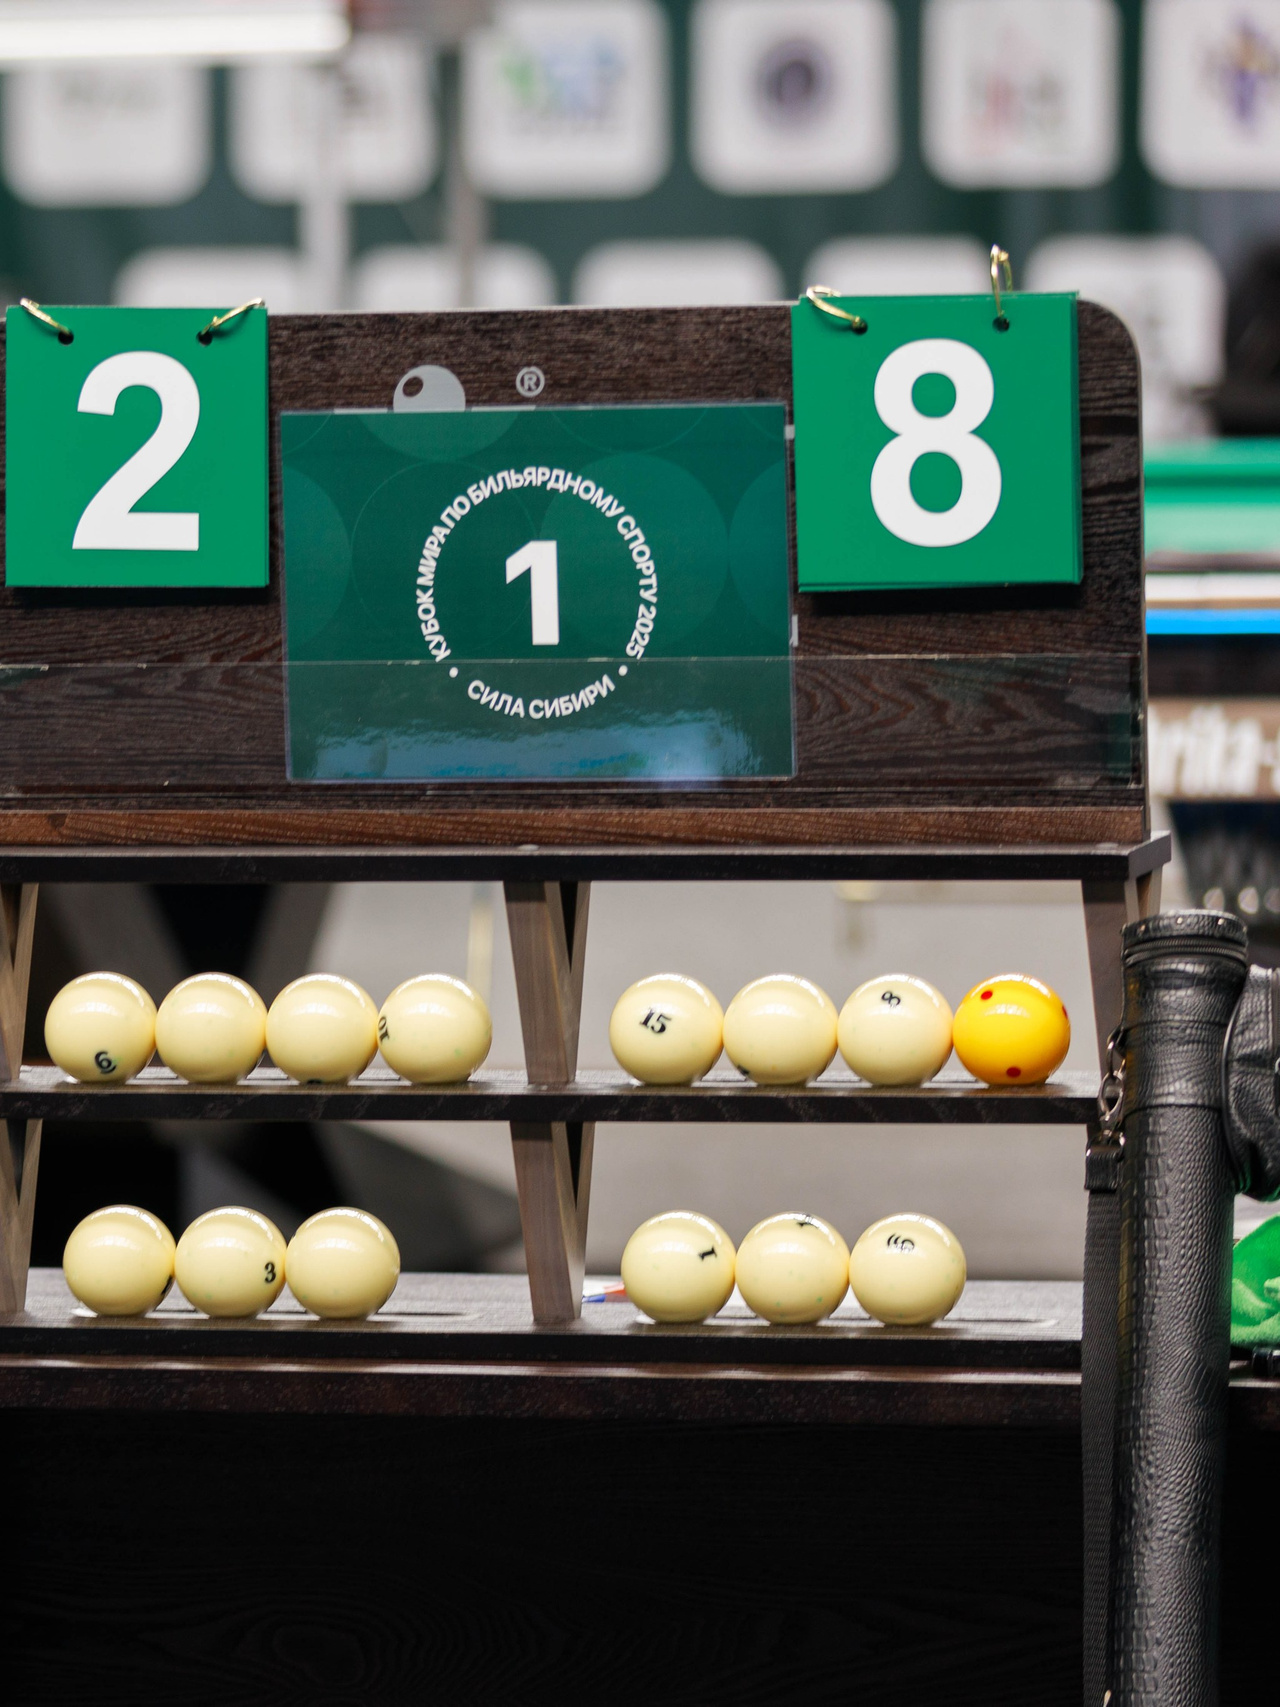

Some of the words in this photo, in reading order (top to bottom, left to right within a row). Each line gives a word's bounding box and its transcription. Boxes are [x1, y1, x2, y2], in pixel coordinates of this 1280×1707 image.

[72, 350, 200, 551] 2
[870, 337, 1002, 547] 8
[440, 495, 471, 529] ПО
[466, 466, 625, 518] БИЛЬЯРДНОМУ
[416, 525, 452, 586] МИРА
[616, 515, 658, 603] СПОРТУ
[505, 540, 560, 646] 1
[416, 587, 451, 662] КУБОК
[625, 604, 657, 660] 2025
[467, 679, 525, 719] СИЛА
[528, 673, 616, 719] СИБИРИ
[639, 1008, 671, 1033] 15
[95, 1051, 116, 1074] 6
[265, 1262, 276, 1283] 3
